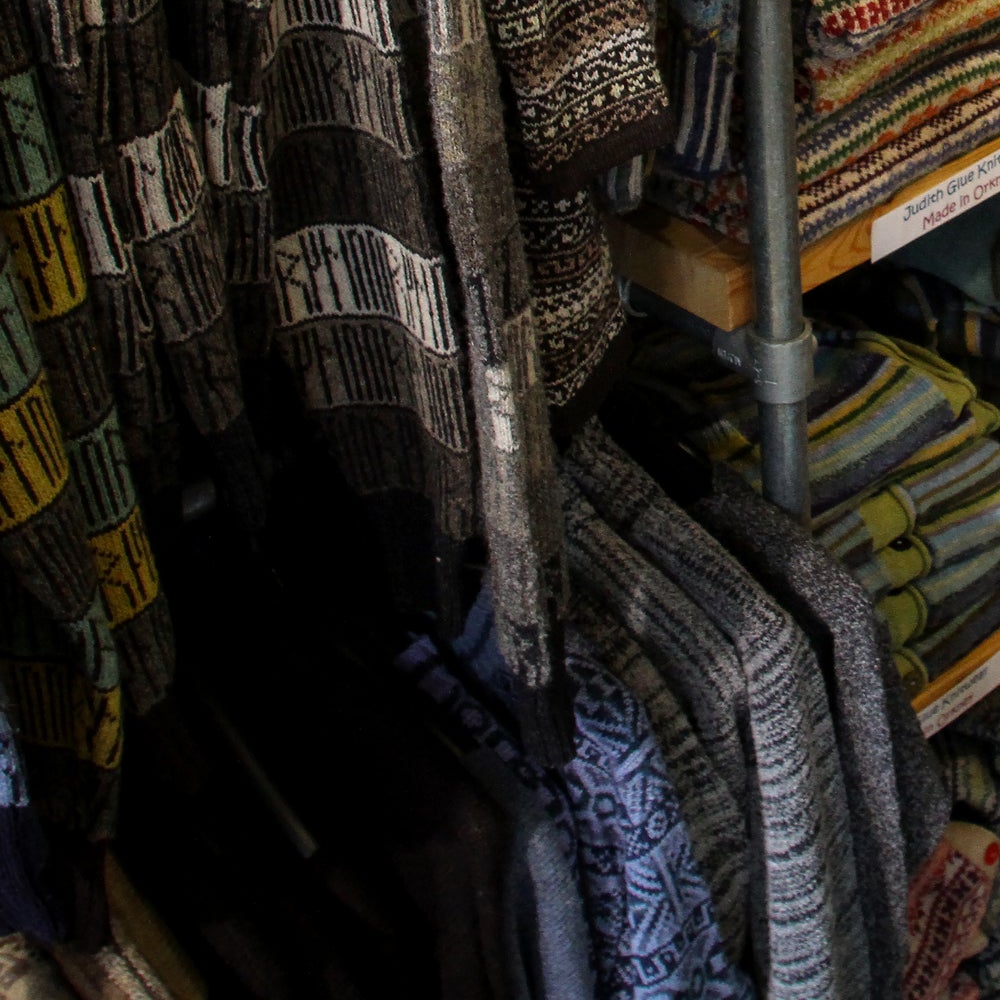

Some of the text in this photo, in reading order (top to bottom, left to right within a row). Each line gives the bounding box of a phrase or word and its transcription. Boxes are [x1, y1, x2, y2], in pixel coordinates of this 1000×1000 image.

[903, 189, 944, 222] Judith
[947, 170, 975, 196] Glue
[922, 205, 956, 231] Made
[959, 194, 970, 210] in
